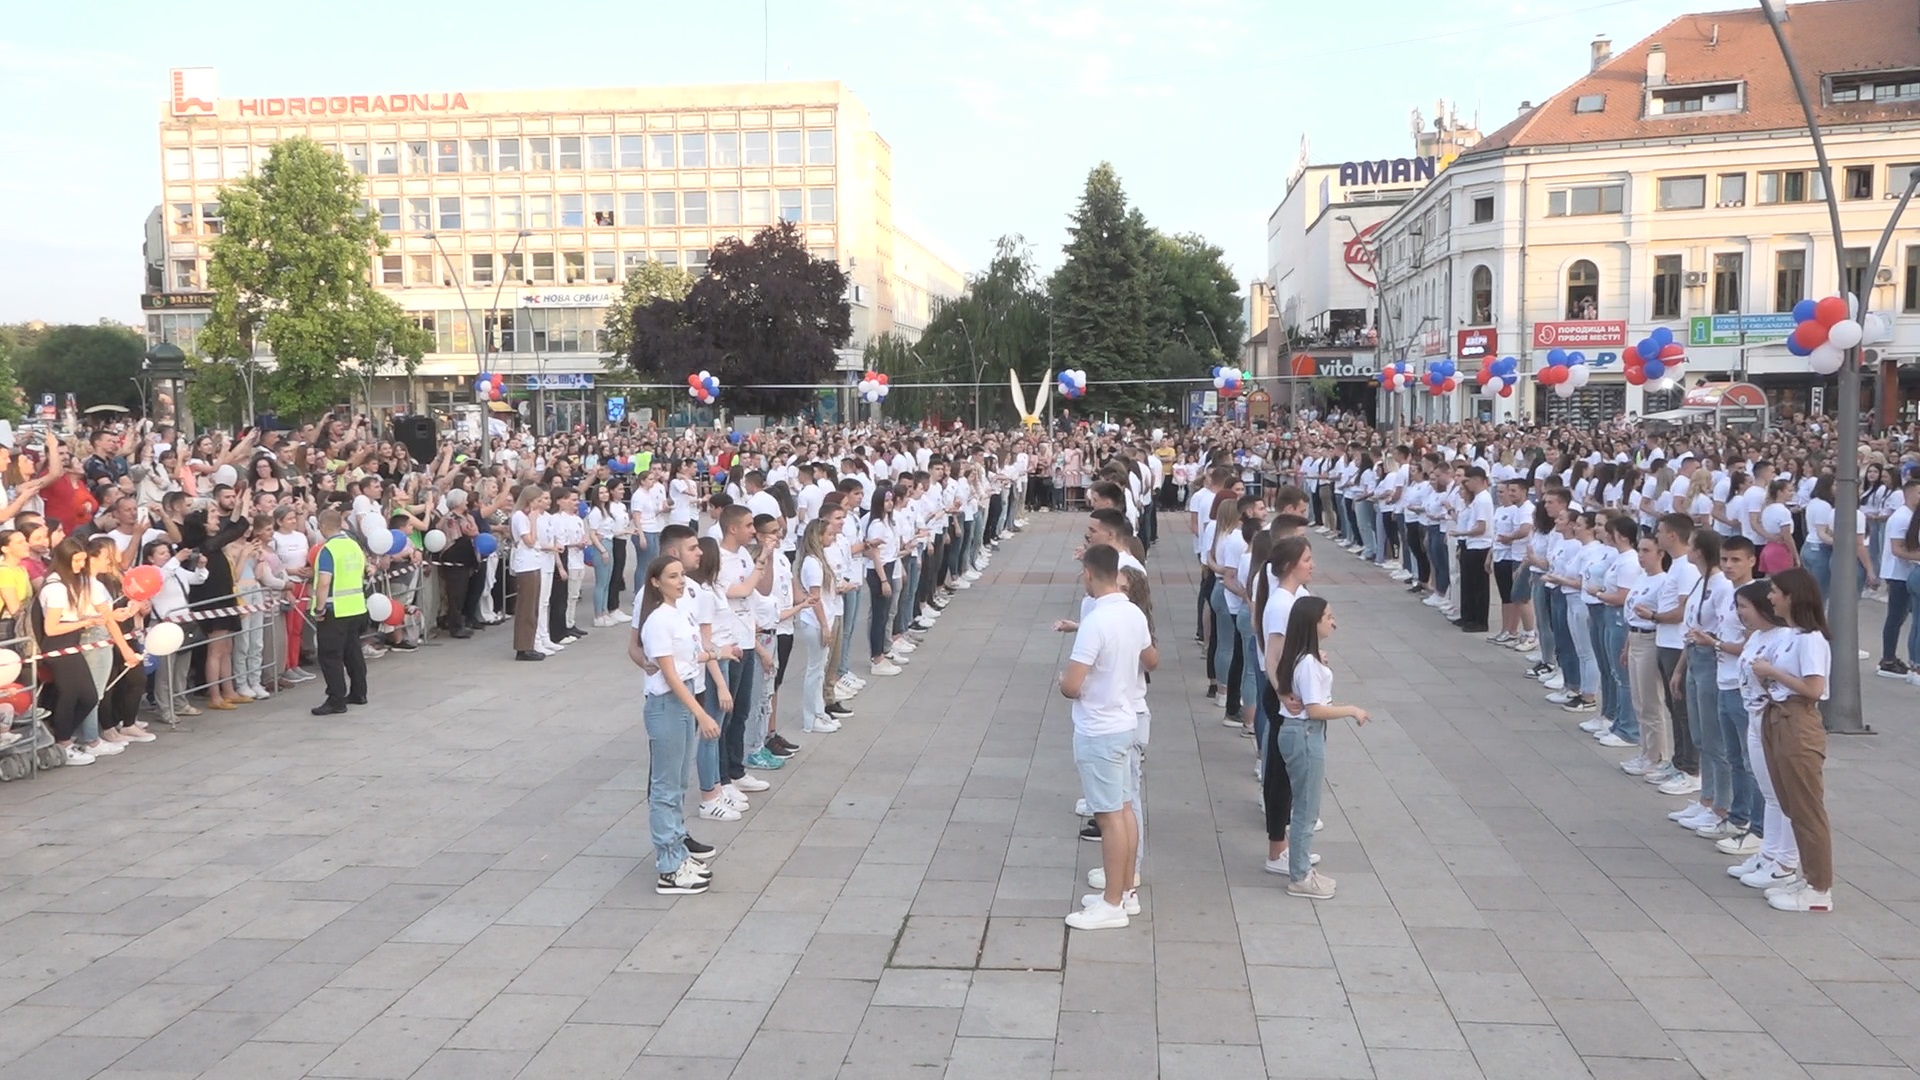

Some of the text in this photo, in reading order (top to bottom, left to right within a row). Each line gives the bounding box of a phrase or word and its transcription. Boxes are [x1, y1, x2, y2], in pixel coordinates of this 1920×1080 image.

[239, 93, 468, 115] HIDROGRADNJA
[1340, 156, 1435, 186] AMAN
[543, 294, 570, 303] НОВА
[574, 293, 609, 303] СРБИЈА
[1558, 325, 1606, 334] ПОРОДИЦА
[44, 395, 53, 405] P
